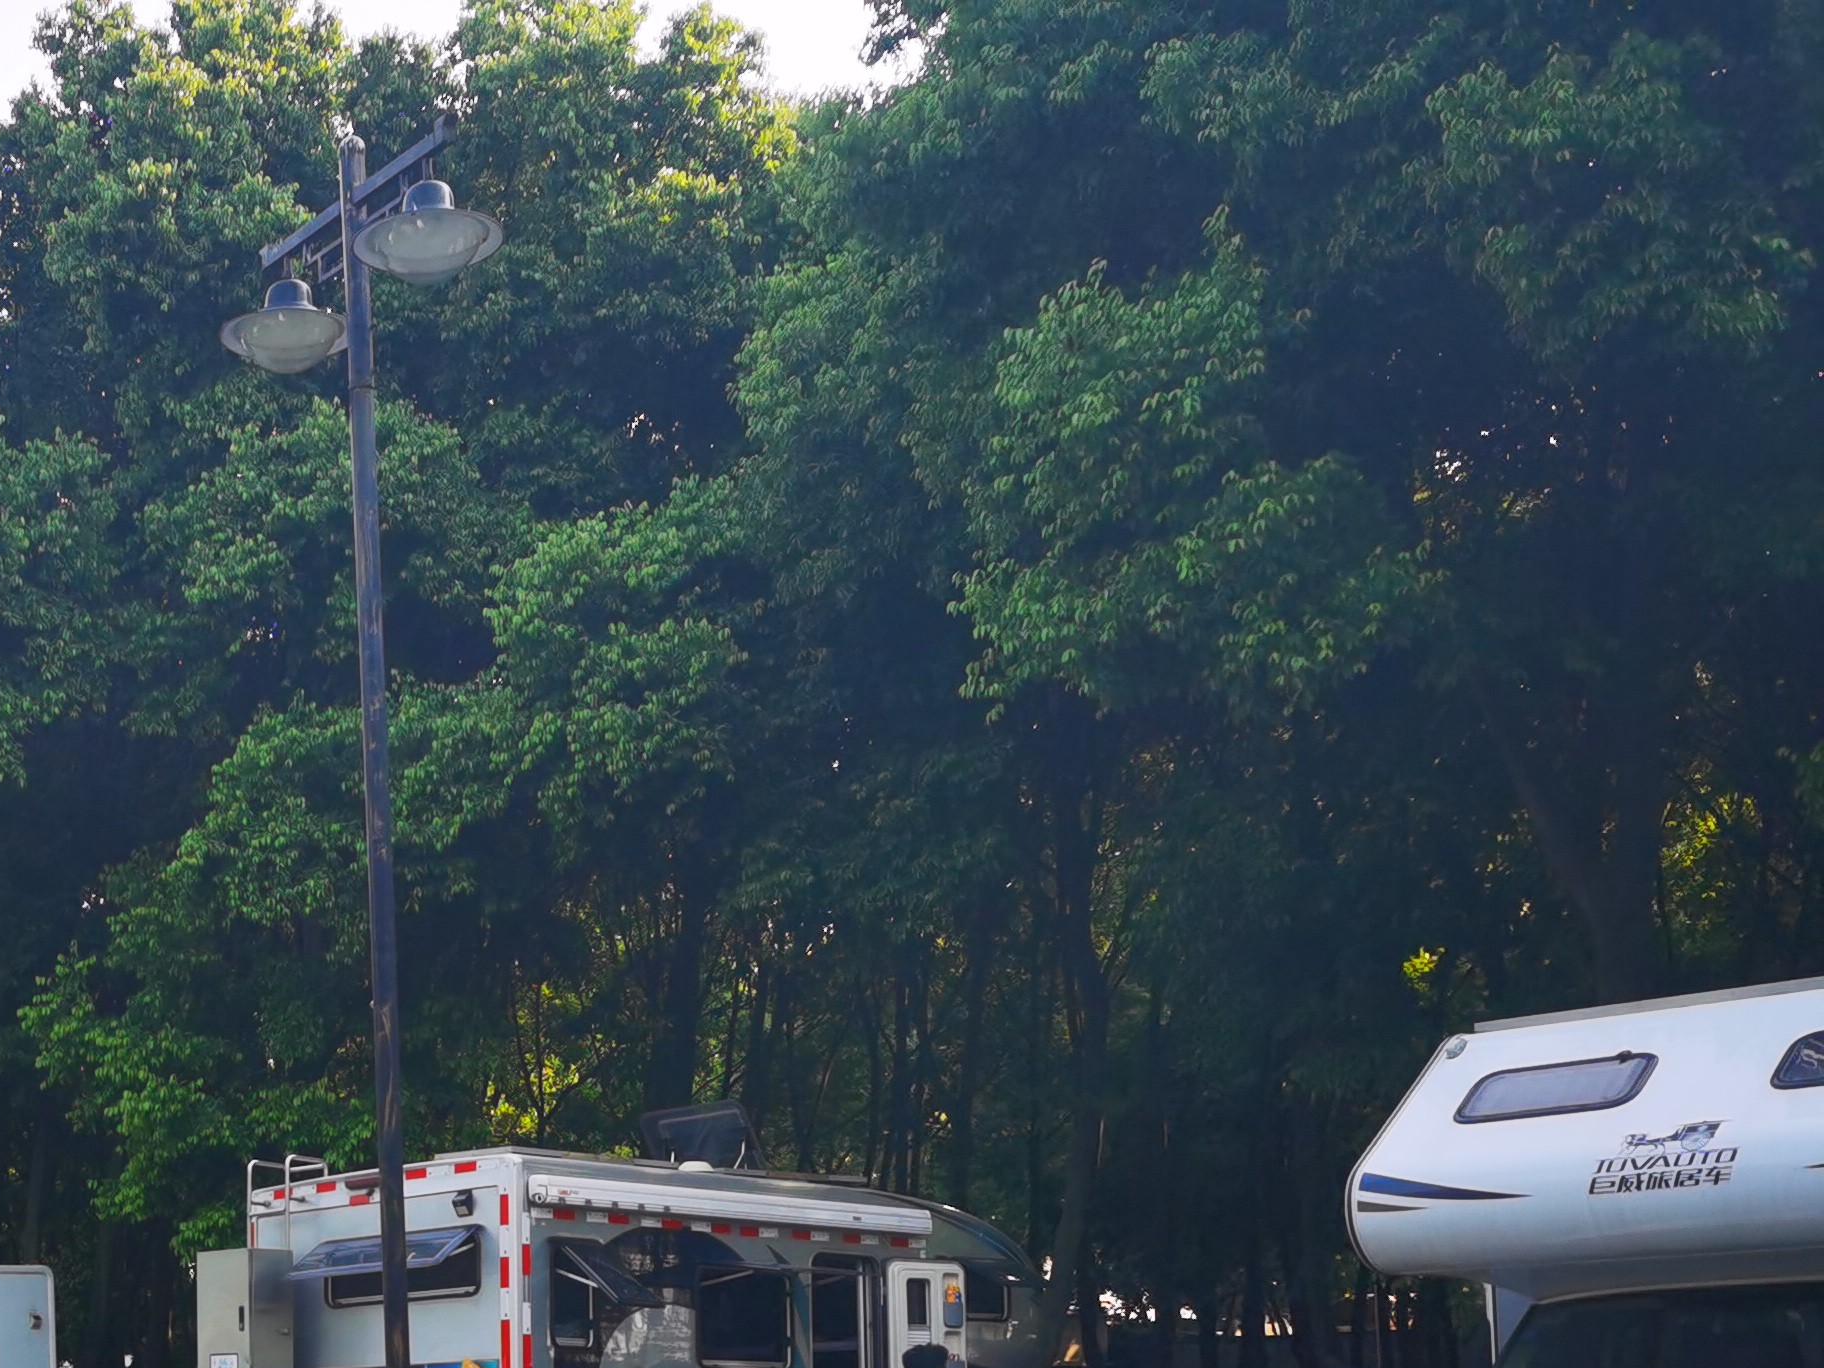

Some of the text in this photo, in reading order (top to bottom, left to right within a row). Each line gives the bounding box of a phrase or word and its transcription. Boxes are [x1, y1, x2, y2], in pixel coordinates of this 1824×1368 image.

[1588, 1165, 1733, 1195] 巨威旅居车
